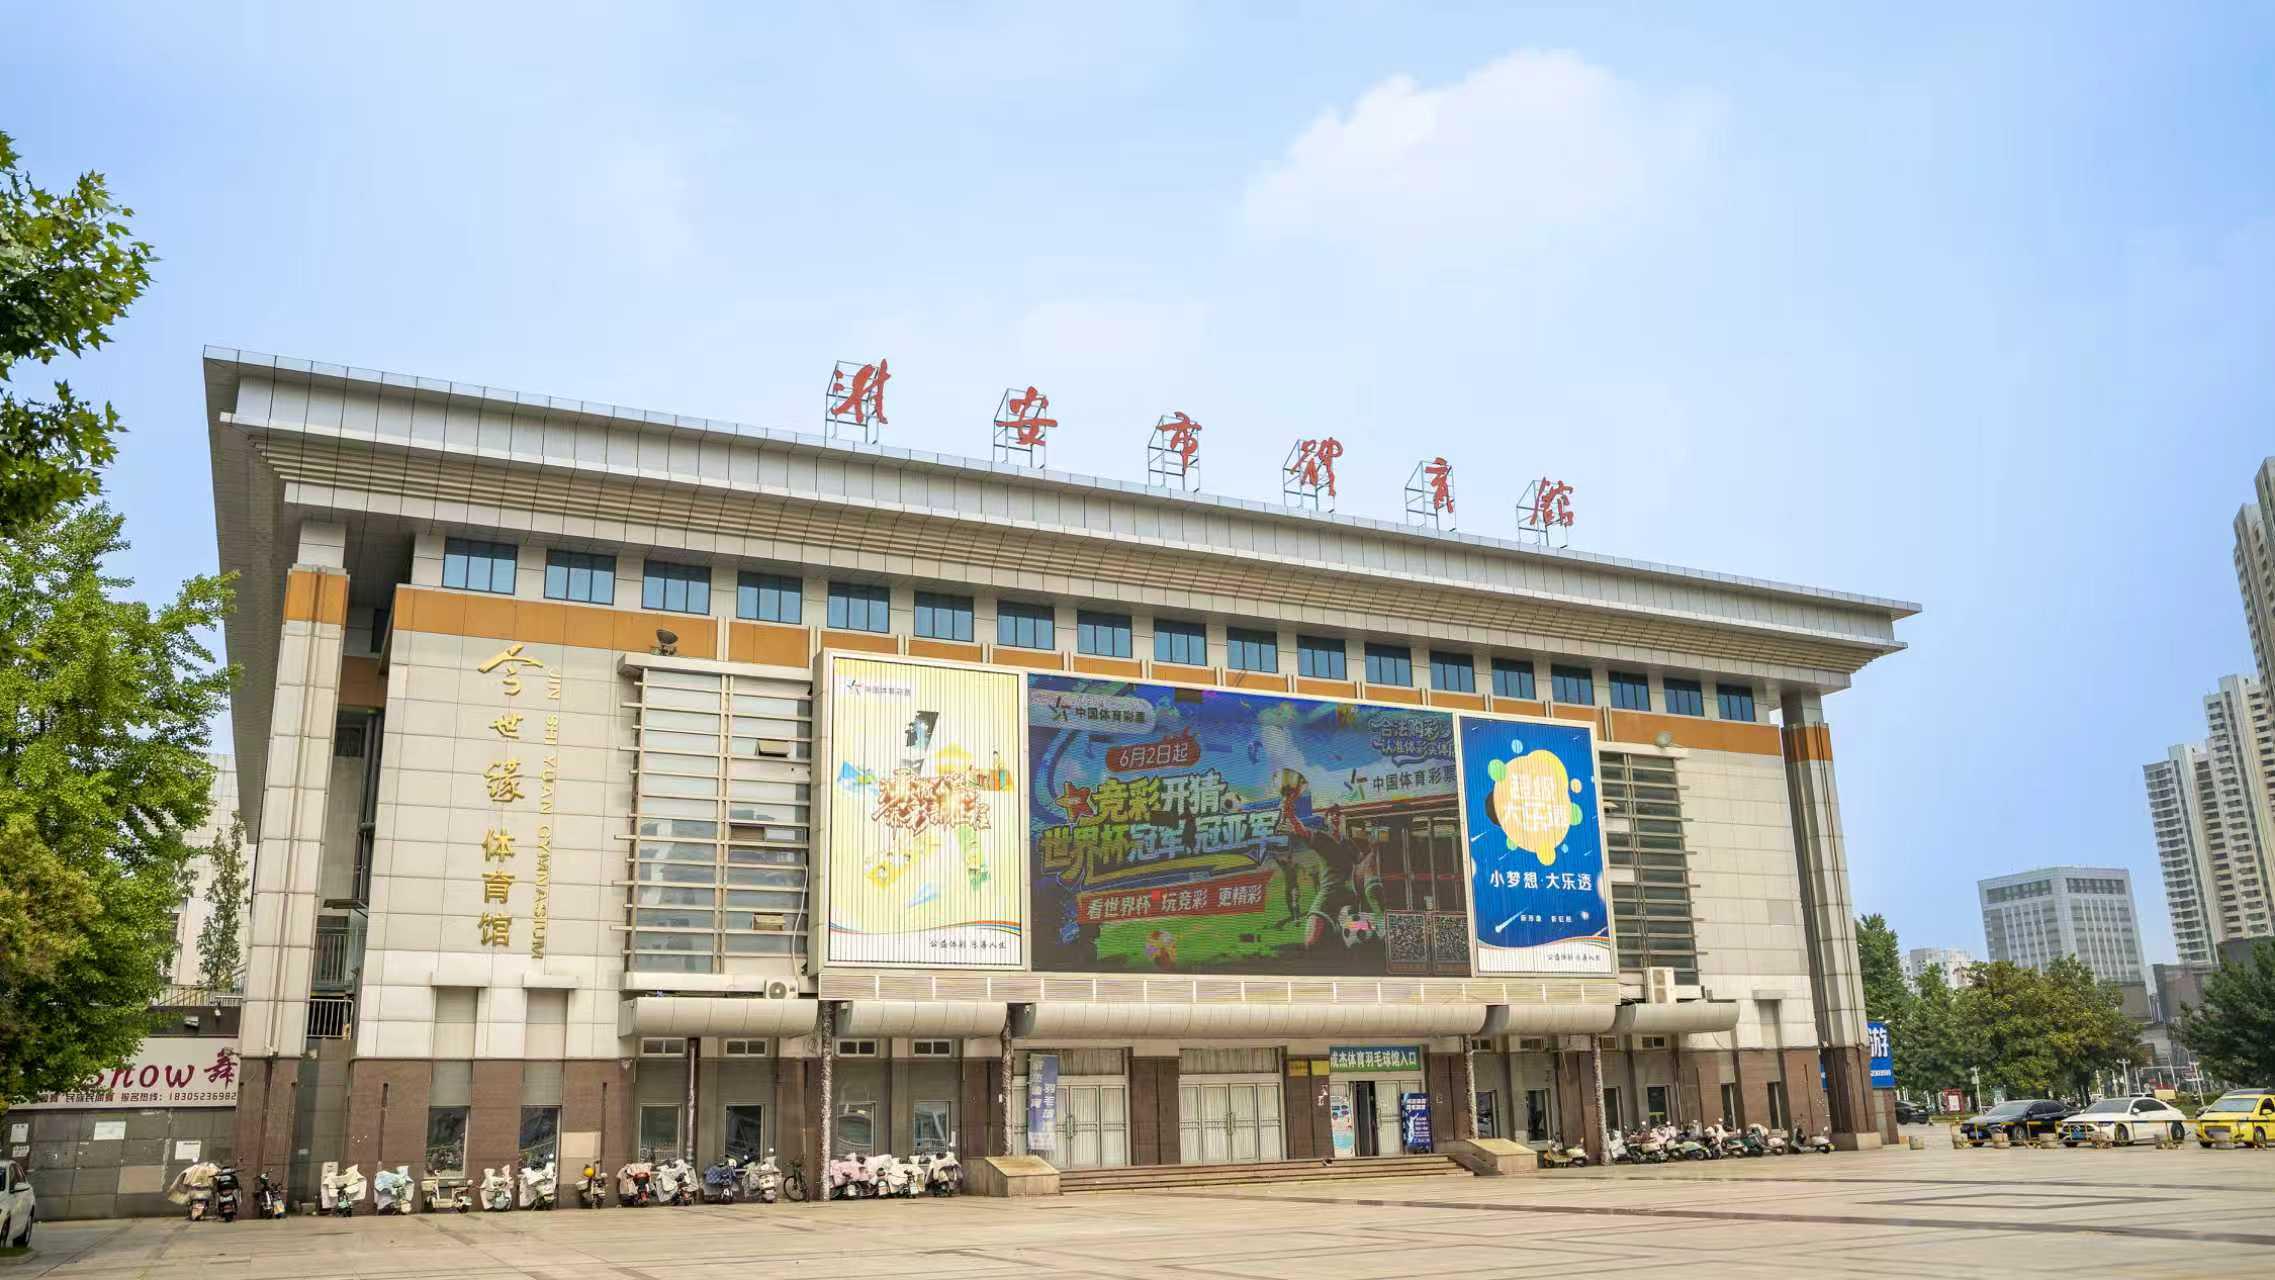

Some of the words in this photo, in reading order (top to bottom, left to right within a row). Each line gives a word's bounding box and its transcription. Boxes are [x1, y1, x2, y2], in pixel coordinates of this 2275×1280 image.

[546, 664, 562, 701] JIN
[543, 713, 559, 746] SHI
[1075, 705, 1146, 724] 中国体育彩票
[1119, 743, 1189, 768] 6月2日起
[539, 755, 558, 815] YUAN
[1093, 770, 1222, 822] 竞彩开猜
[1373, 765, 1456, 793] 中国体育彩票
[1040, 822, 1186, 885] 世界杯冠军
[531, 824, 552, 960] GYMNASIUM
[1087, 895, 1151, 920] 看世界杯
[1161, 887, 1208, 913] 玩竞彩
[1217, 884, 1264, 909] 更精彩
[169, 1092, 237, 1101] 18305236982
